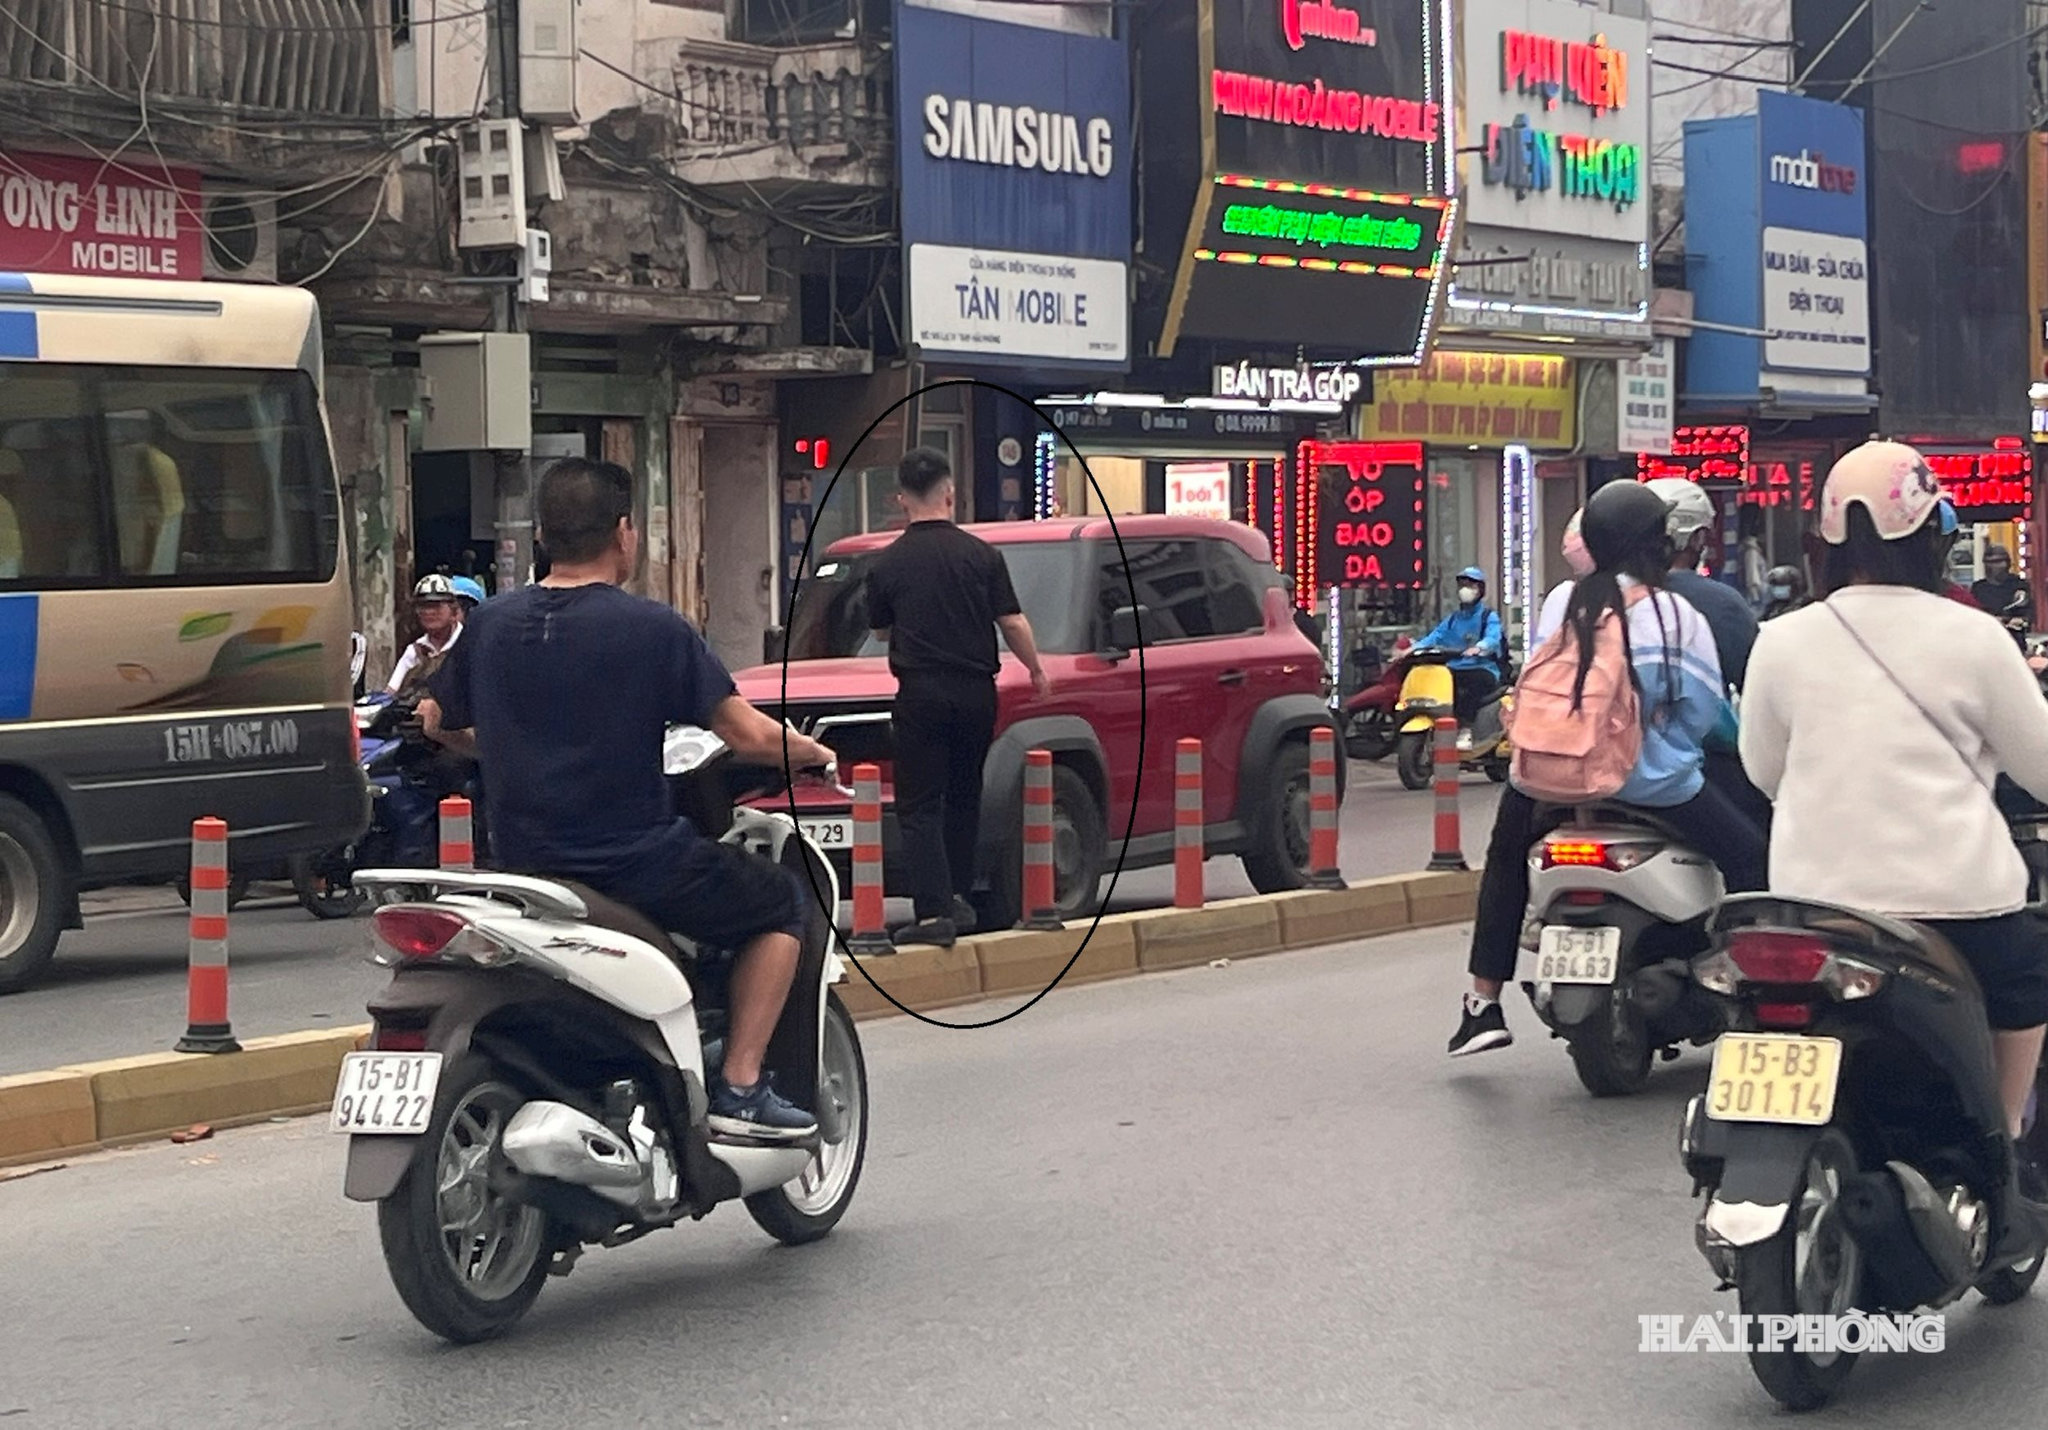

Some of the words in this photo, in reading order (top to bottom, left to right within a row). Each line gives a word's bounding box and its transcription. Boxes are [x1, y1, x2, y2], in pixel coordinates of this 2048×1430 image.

[1499, 29, 1562, 111] PHỤ
[1563, 33, 1627, 117] KIỆN
[1213, 69, 1275, 121] MINH
[1274, 78, 1362, 132] HOÀNG
[1360, 94, 1440, 143] MOBILE
[924, 94, 1112, 177] SAMSUNG
[95, 184, 177, 240] LINH
[72, 241, 178, 275] MOBILE
[1765, 251, 1786, 271] MUA
[1789, 250, 1810, 275] BÁN
[955, 275, 999, 321] TÂN
[1221, 360, 1267, 398] BÁN
[1315, 364, 1359, 402] GÓP
[1171, 481, 1182, 503] 1
[1213, 480, 1225, 502] 1
[1335, 522, 1393, 546] BAO
[1345, 554, 1382, 579] DA
[358, 1060, 423, 1091] 15-B1
[1737, 1041, 1820, 1077] 15-B3
[339, 1095, 428, 1127] 944.22
[1715, 1079, 1823, 1118] 301.14
